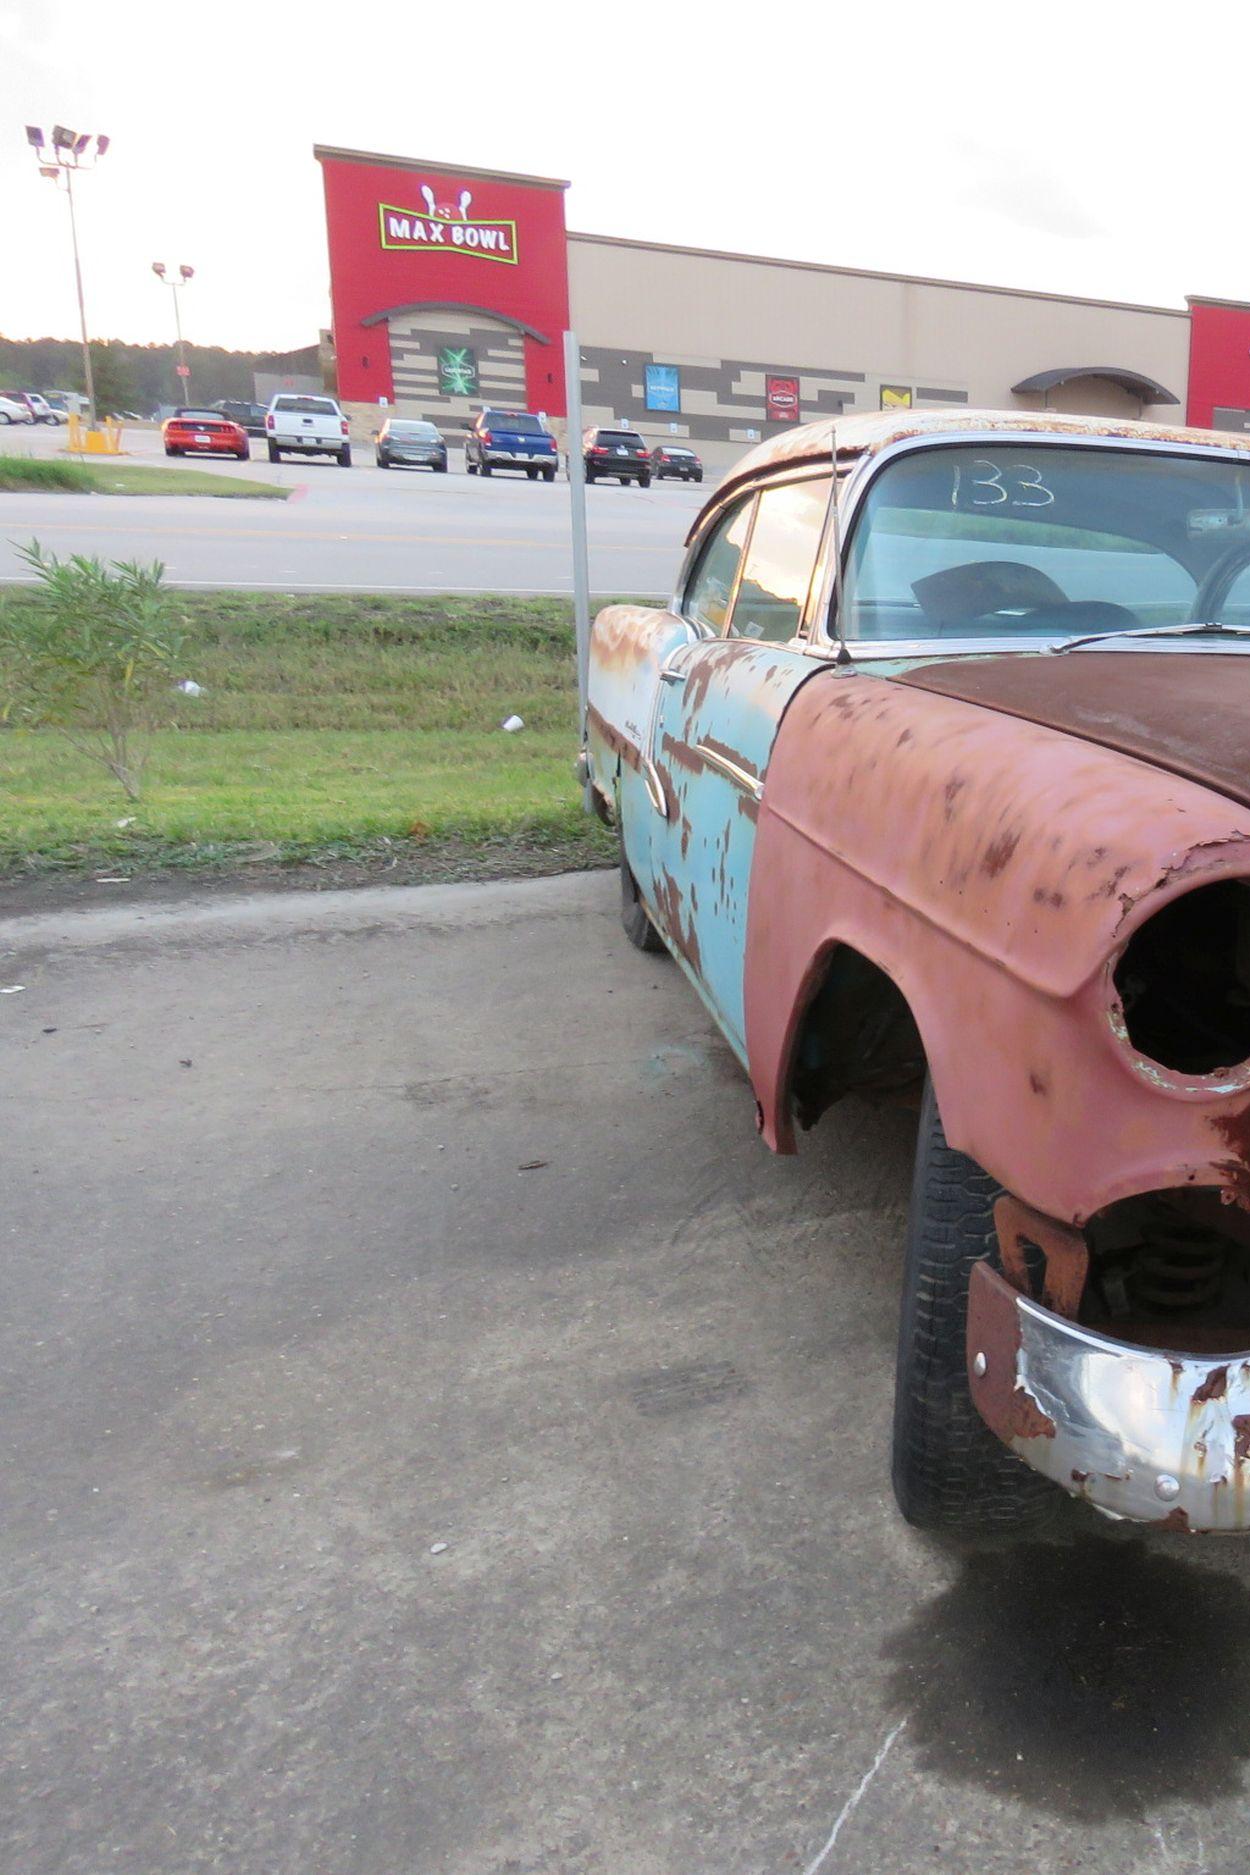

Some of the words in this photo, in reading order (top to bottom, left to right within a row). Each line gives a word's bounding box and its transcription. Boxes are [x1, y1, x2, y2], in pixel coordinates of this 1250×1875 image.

[388, 216, 445, 243] MAX
[451, 225, 510, 251] BOWL
[951, 459, 1055, 507] 133
